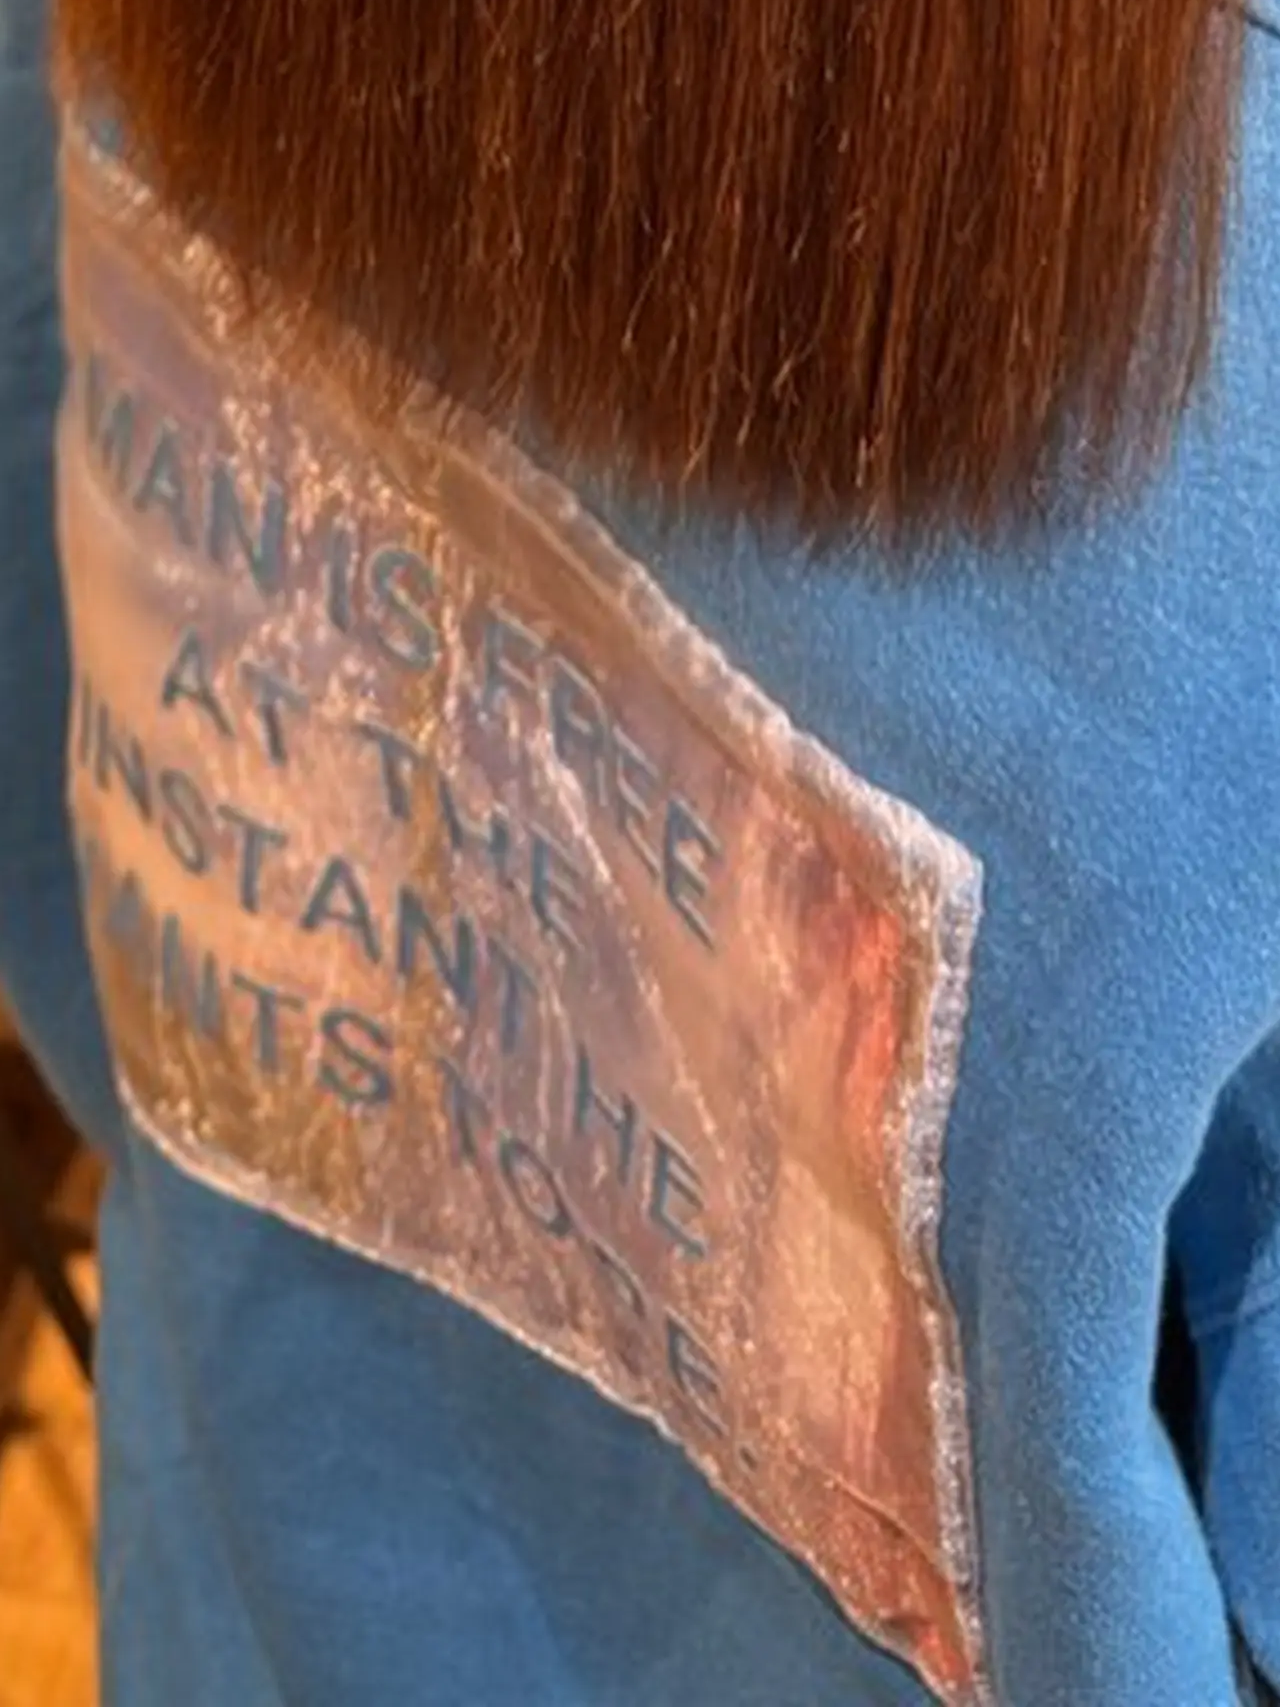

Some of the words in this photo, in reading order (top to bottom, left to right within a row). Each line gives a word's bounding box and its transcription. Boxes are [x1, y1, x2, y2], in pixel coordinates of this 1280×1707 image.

[86, 359, 286, 595] MAN
[326, 521, 439, 670] IS
[482, 599, 723, 951] FREE
[163, 627, 310, 767] AT
[356, 720, 586, 949] THE
[77, 675, 540, 1054] INSTANT
[578, 1045, 708, 1259] HE
